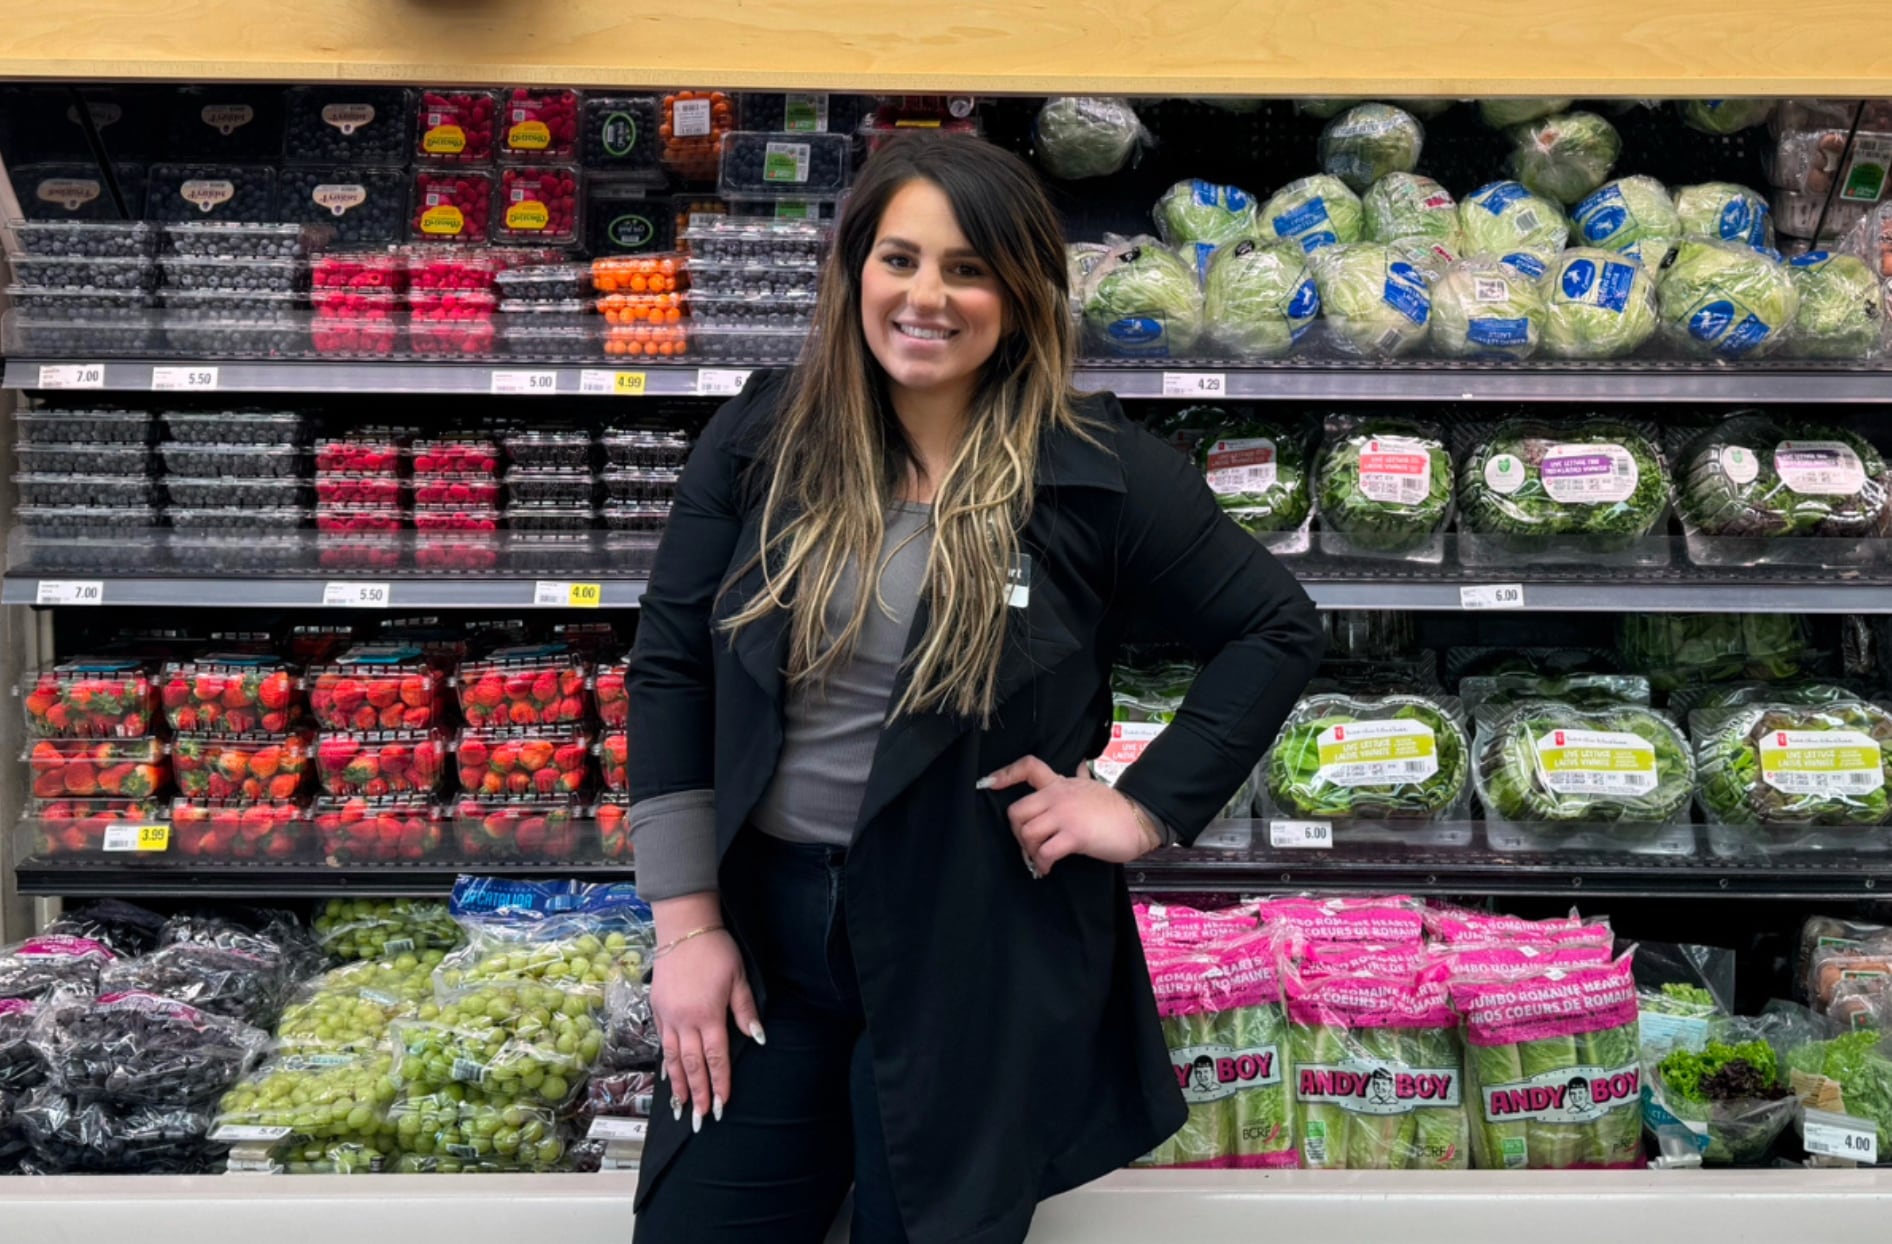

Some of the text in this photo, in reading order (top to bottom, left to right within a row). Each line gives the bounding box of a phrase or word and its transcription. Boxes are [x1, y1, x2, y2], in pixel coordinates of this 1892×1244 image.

[76, 369, 99, 383] 7.00
[188, 373, 212, 385] 5.50
[529, 375, 552, 388] 5.00
[617, 376, 642, 389] 4.99
[1198, 378, 1221, 391] 4.29
[75, 586, 97, 599] 7.00
[360, 588, 383, 601] 5.50
[572, 586, 595, 599] 4.00
[1495, 589, 1518, 602] 6.00
[142, 828, 165, 842] 3.99
[1305, 826, 1327, 840] 6.00
[1210, 968, 1272, 990] ROMAINE
[1468, 972, 1632, 1011] JUMBO ROMAINE HEARTS
[1323, 992, 1378, 1009] COEURS
[1505, 1003, 1561, 1022] COEURS
[1563, 999, 1583, 1013] DE
[1216, 1051, 1275, 1084] BOY
[1300, 1069, 1452, 1100] ANDY BOY
[1490, 1066, 1640, 1115] ANDY BOY
[1844, 1134, 1870, 1152] 4.00
